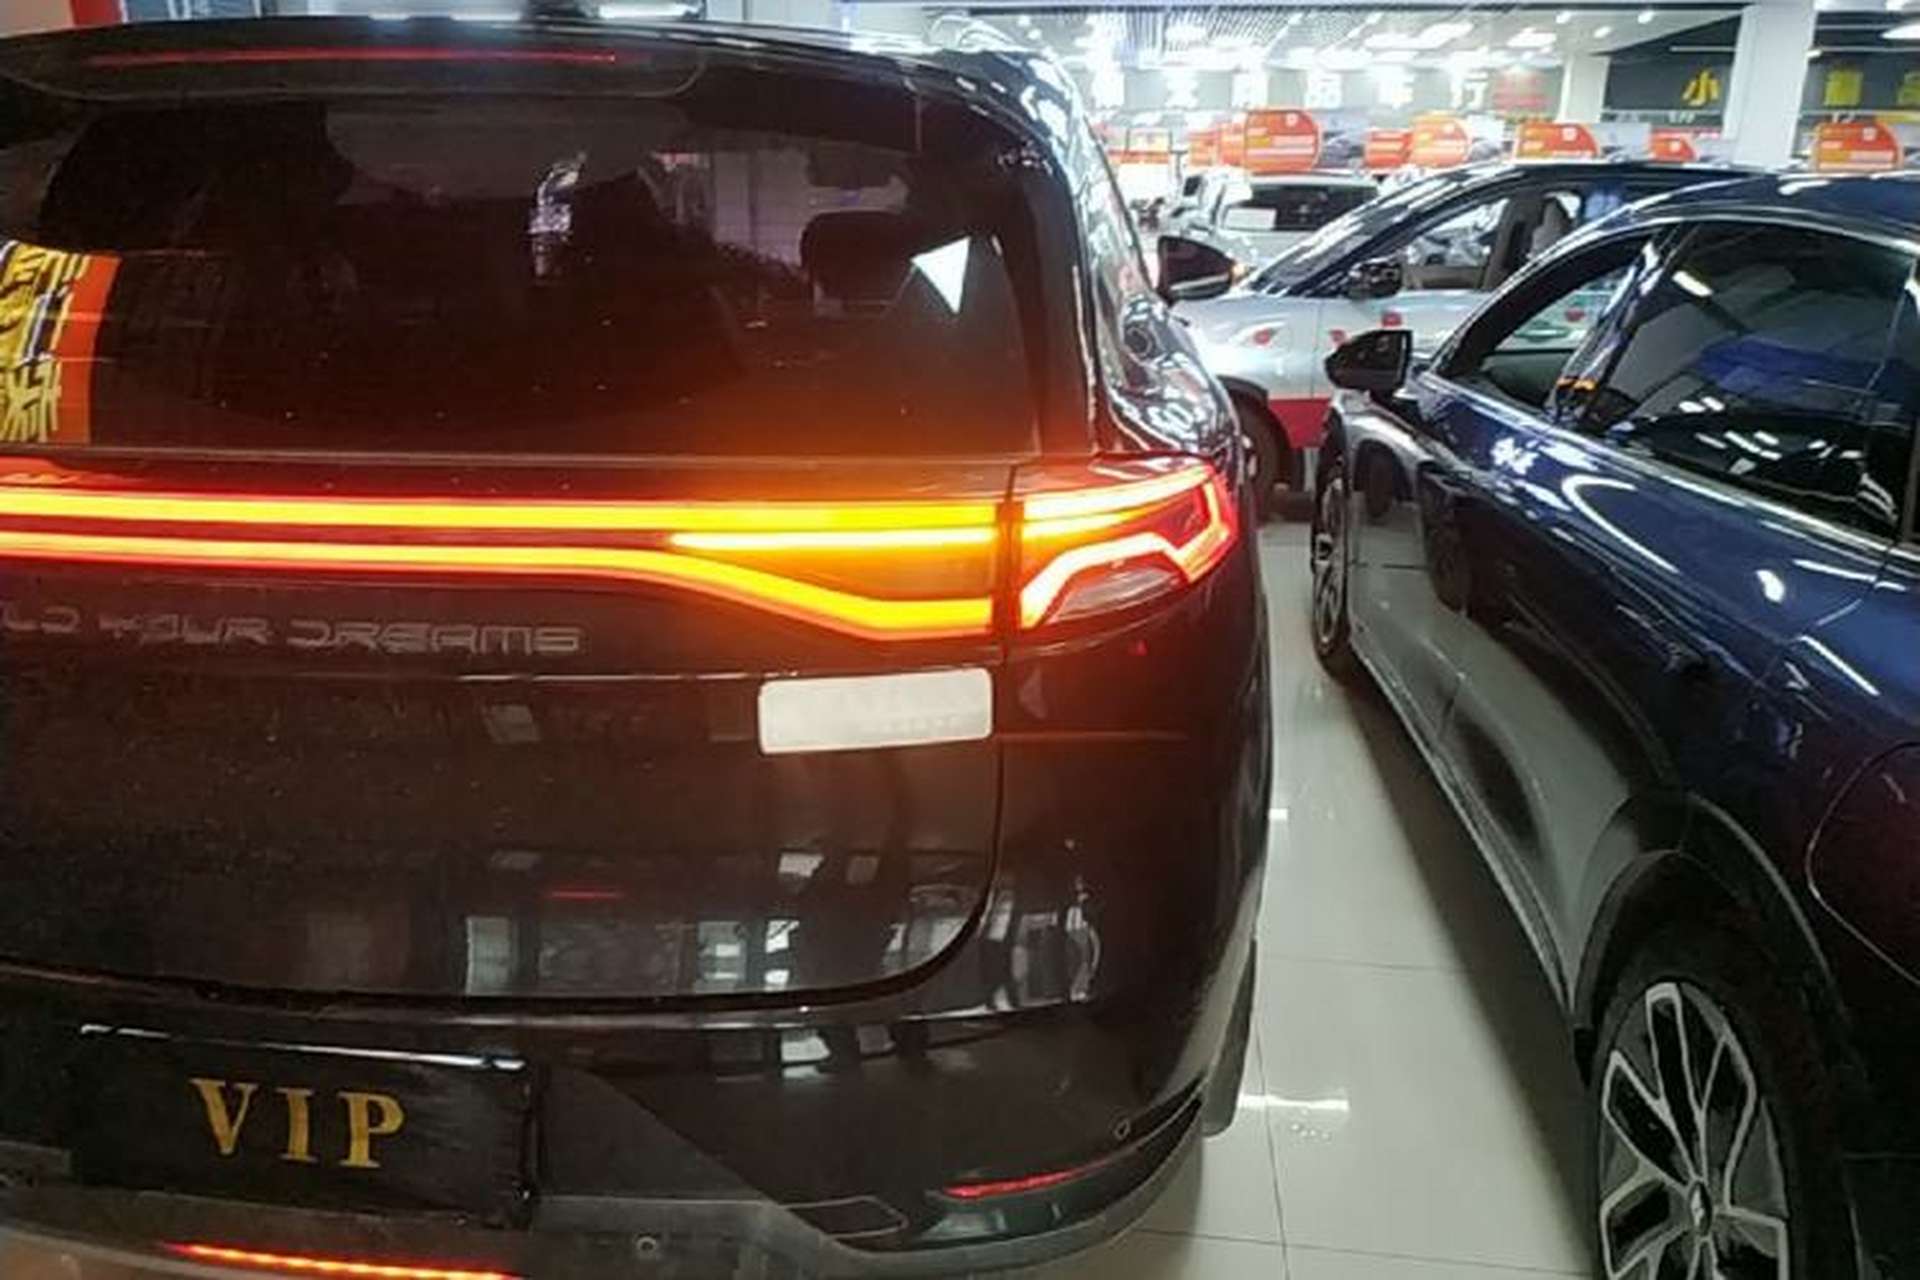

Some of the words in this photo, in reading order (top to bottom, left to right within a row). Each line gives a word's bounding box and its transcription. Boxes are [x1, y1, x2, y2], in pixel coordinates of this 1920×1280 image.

[100, 612, 272, 646] YOUR
[287, 619, 583, 656] DREAMS
[189, 1077, 405, 1168] VIP
